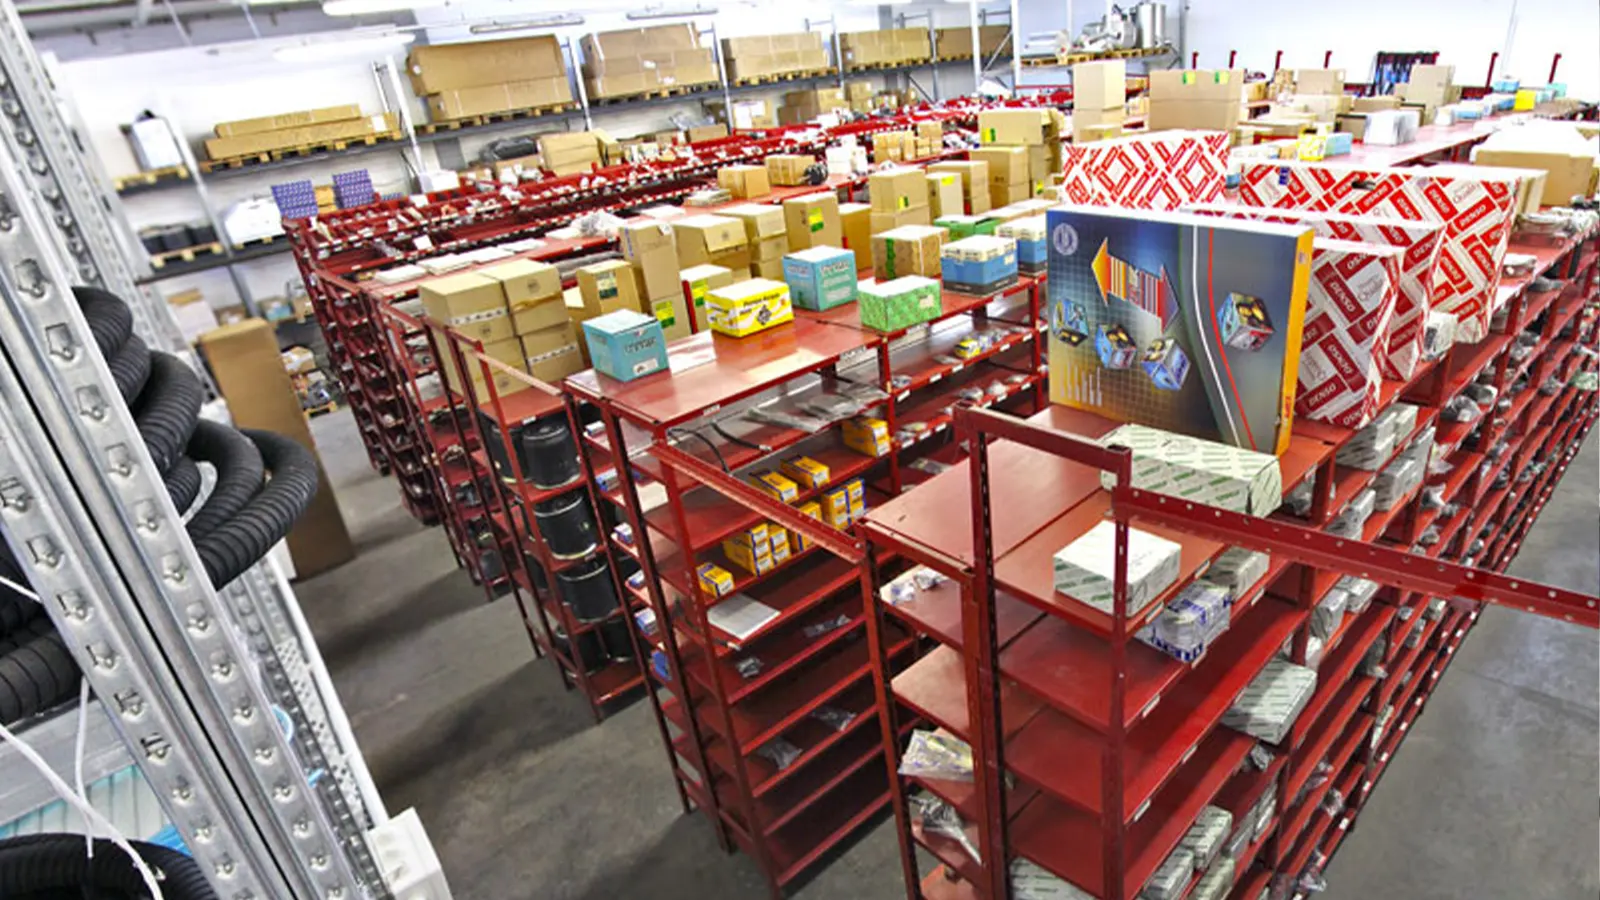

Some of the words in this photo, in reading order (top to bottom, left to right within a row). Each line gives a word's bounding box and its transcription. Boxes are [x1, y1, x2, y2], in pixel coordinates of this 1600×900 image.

[1329, 281, 1357, 312] DENSO
[1327, 344, 1354, 376] DENSO
[1308, 384, 1338, 408] DENSO
